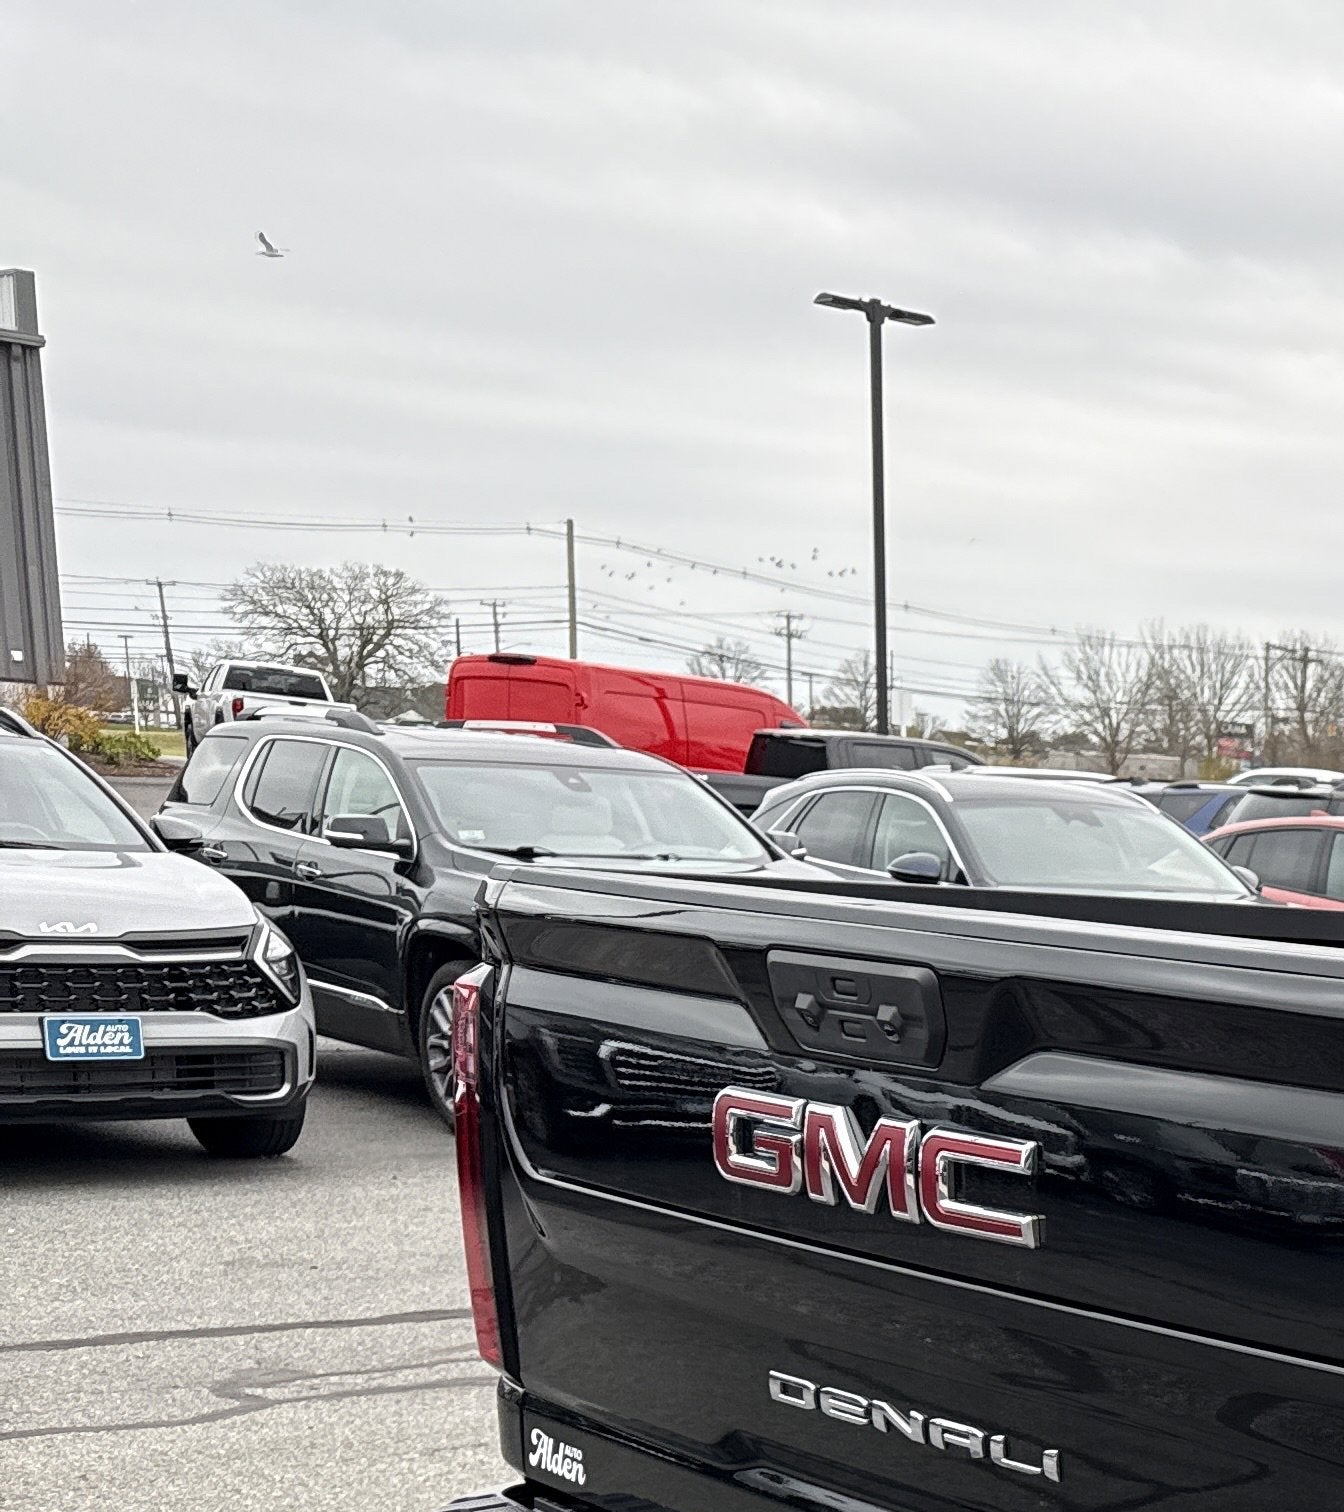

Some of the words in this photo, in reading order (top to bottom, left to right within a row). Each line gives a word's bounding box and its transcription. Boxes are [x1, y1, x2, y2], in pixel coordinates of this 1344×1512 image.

[56, 1023, 133, 1047] Alden
[106, 1024, 129, 1032] AUTO
[712, 1085, 1046, 1250] GMC
[769, 1370, 1062, 1482] DENALI
[528, 1427, 587, 1486] Alden
